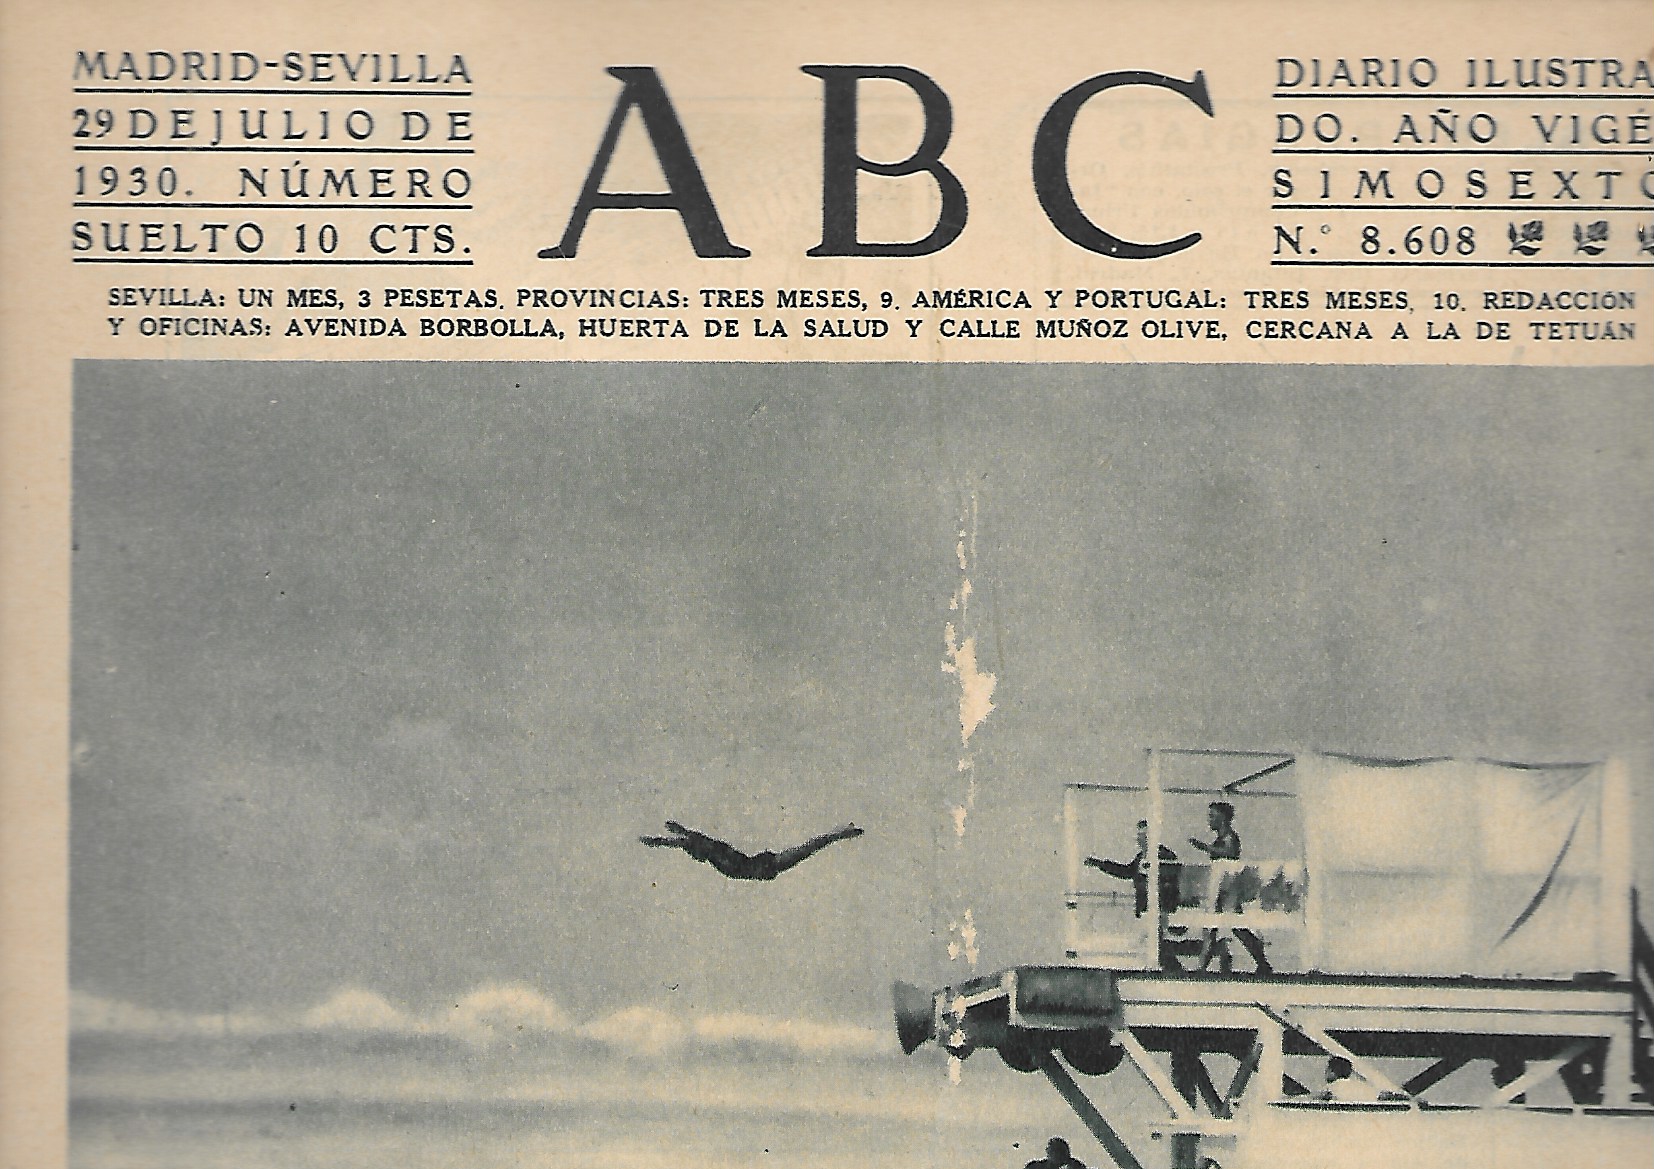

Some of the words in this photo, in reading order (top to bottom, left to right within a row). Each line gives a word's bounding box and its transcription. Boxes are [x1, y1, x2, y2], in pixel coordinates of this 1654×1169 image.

[72, 50, 474, 85] MADRID-SEVILLA
[1274, 57, 1438, 89] DIARIO
[1465, 57, 1654, 89] ILUSTRA
[72, 108, 114, 140] 29
[128, 109, 197, 140] DE
[208, 109, 376, 147] JULIO
[400, 110, 474, 142] DE
[1274, 112, 1360, 144] DO.
[1391, 107, 1499, 145] AÑO
[1529, 107, 1654, 145] VIGÉ
[74, 164, 194, 197] 1930.
[237, 159, 472, 199] NÚMERO
[70, 220, 265, 254] SUELTO
[295, 223, 339, 254] 10
[368, 223, 471, 255] CTS.
[1360, 225, 1477, 256] 8.608
[107, 287, 226, 308] SEVILLA:
[237, 287, 275, 308] UN
[285, 288, 345, 311] MES,
[357, 289, 372, 309] 3
[383, 288, 505, 310] PESETAS.
[516, 288, 690, 309] PROVINCIAS:
[698, 288, 765, 309] TRES
[775, 289, 868, 312] MESES,
[879, 290, 901, 311] 9.
[911, 288, 1033, 309] AMÉRICA
[1043, 289, 1064, 309] Y
[1074, 289, 1227, 309] PORTUGAL:
[1242, 290, 1310, 310] TRES
[1324, 290, 1416, 313] MESES,
[1433, 292, 1467, 313] 10.
[1481, 290, 1637, 311] REDACCIÓN
[105, 316, 126, 337] Y
[137, 316, 272, 337] OFICINAS:
[283, 317, 408, 338] AVENIDA
[419, 318, 565, 341] BORBOLLA,
[577, 317, 690, 338] HUERTA
[703, 319, 740, 338] DE
[753, 318, 789, 338] LA
[803, 318, 889, 338] SALUD
[904, 319, 924, 338] Y
[936, 318, 1021, 339] CALLE
[1035, 317, 1129, 339] MUÑOZ
[1140, 319, 1228, 342] OLIVE,
[1245, 320, 1374, 340] CERCANA
[1389, 321, 1410, 340] A
[1426, 321, 1462, 341] LA
[1475, 321, 1512, 341] DE
[1527, 320, 1637, 341] TETUÁN
